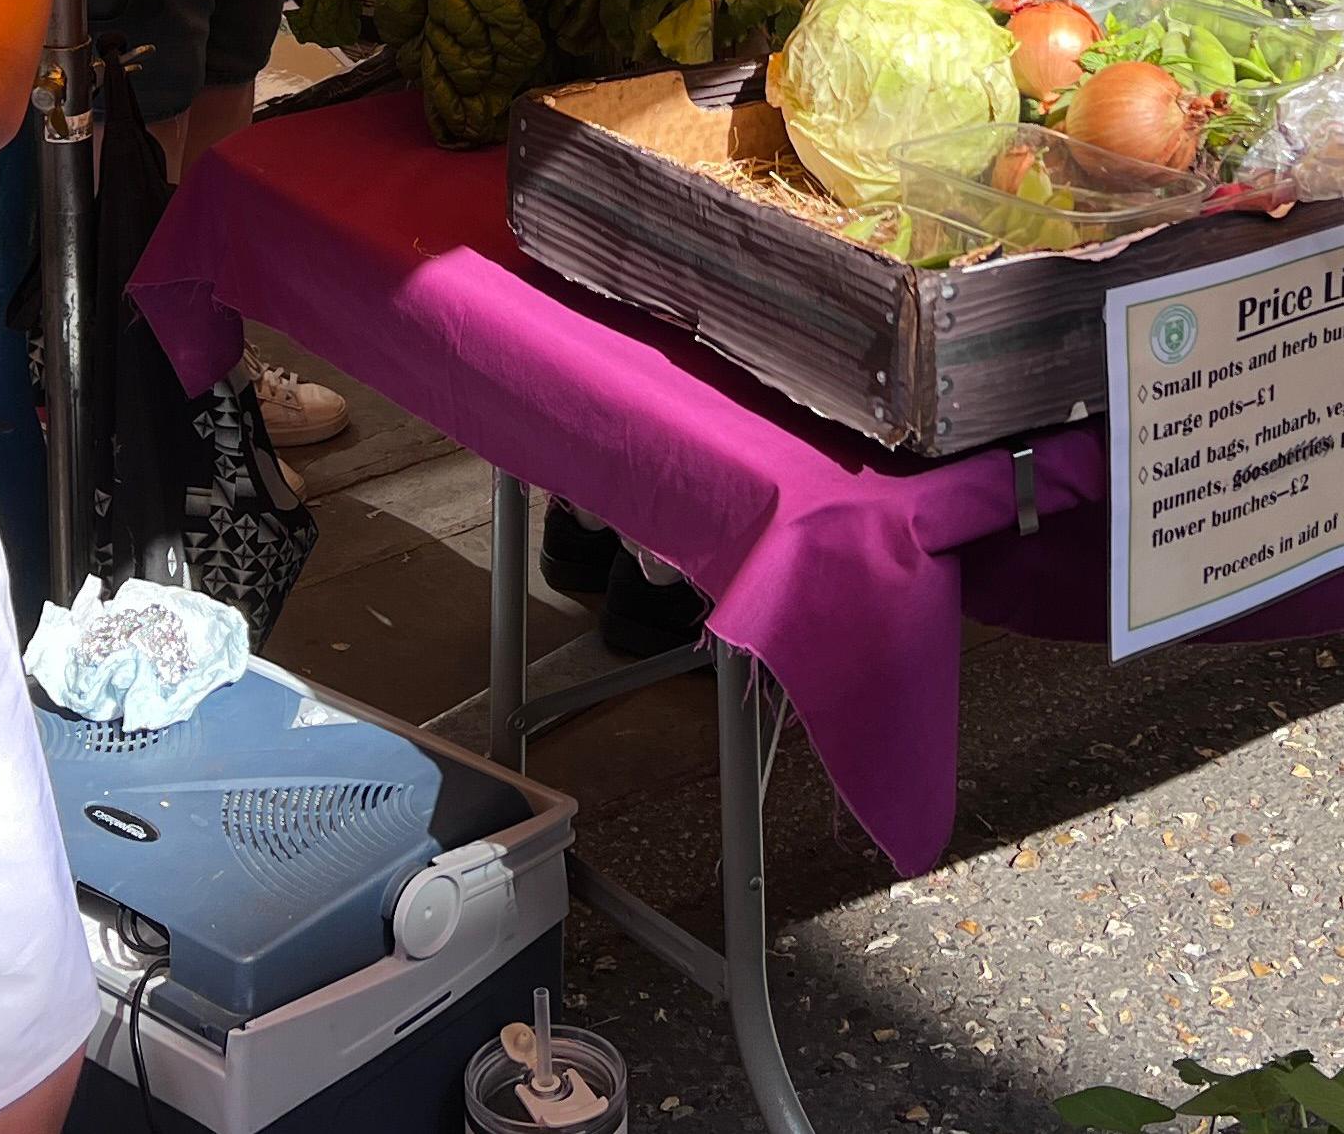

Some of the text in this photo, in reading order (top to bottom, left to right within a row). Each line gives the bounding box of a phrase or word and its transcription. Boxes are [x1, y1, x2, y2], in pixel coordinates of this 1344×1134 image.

[1238, 284, 1312, 332] Price
[1152, 370, 1202, 401] Small
[1209, 361, 1243, 388] pots
[1249, 346, 1276, 371] and
[1282, 335, 1318, 360] herb
[1152, 412, 1203, 442] Large
[1152, 451, 1200, 482] Salad
[1206, 436, 1249, 466] bags,
[1255, 406, 1321, 446] rhubarb,
[1152, 481, 1226, 519] punnets,
[1152, 515, 1205, 548] flower
[1203, 511, 1338, 584] Proceeds in aid of
